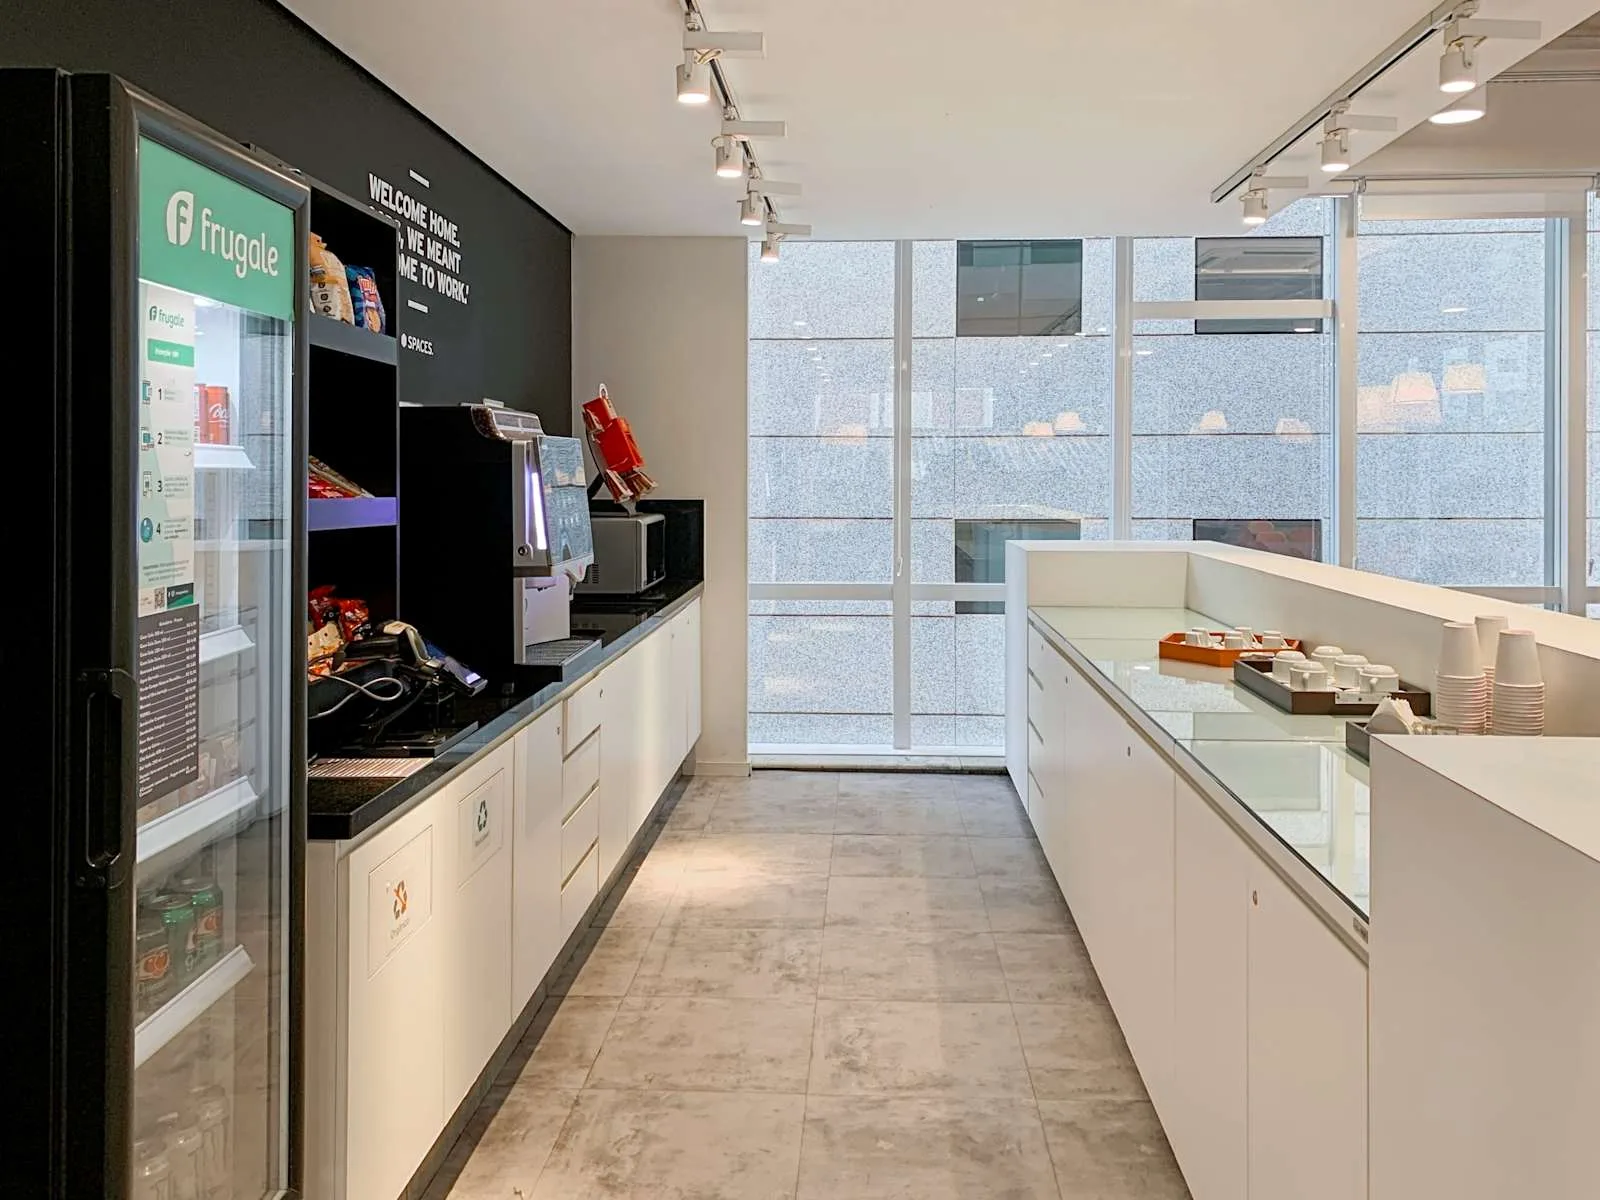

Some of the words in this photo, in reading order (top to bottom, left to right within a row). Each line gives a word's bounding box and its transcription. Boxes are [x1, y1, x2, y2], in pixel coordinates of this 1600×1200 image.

[368, 172, 428, 229] WELCOME
[429, 209, 461, 248] HOME.
[201, 207, 279, 279] frugale
[407, 225, 425, 257] WE
[426, 236, 462, 274] MEANT
[420, 261, 435, 290] TO
[159, 308, 185, 328] frugale
[407, 335, 434, 356] SPACES.
[158, 388, 162, 401] 1
[157, 432, 163, 445] 2
[157, 480, 163, 493] 3
[156, 522, 161, 535] 4
